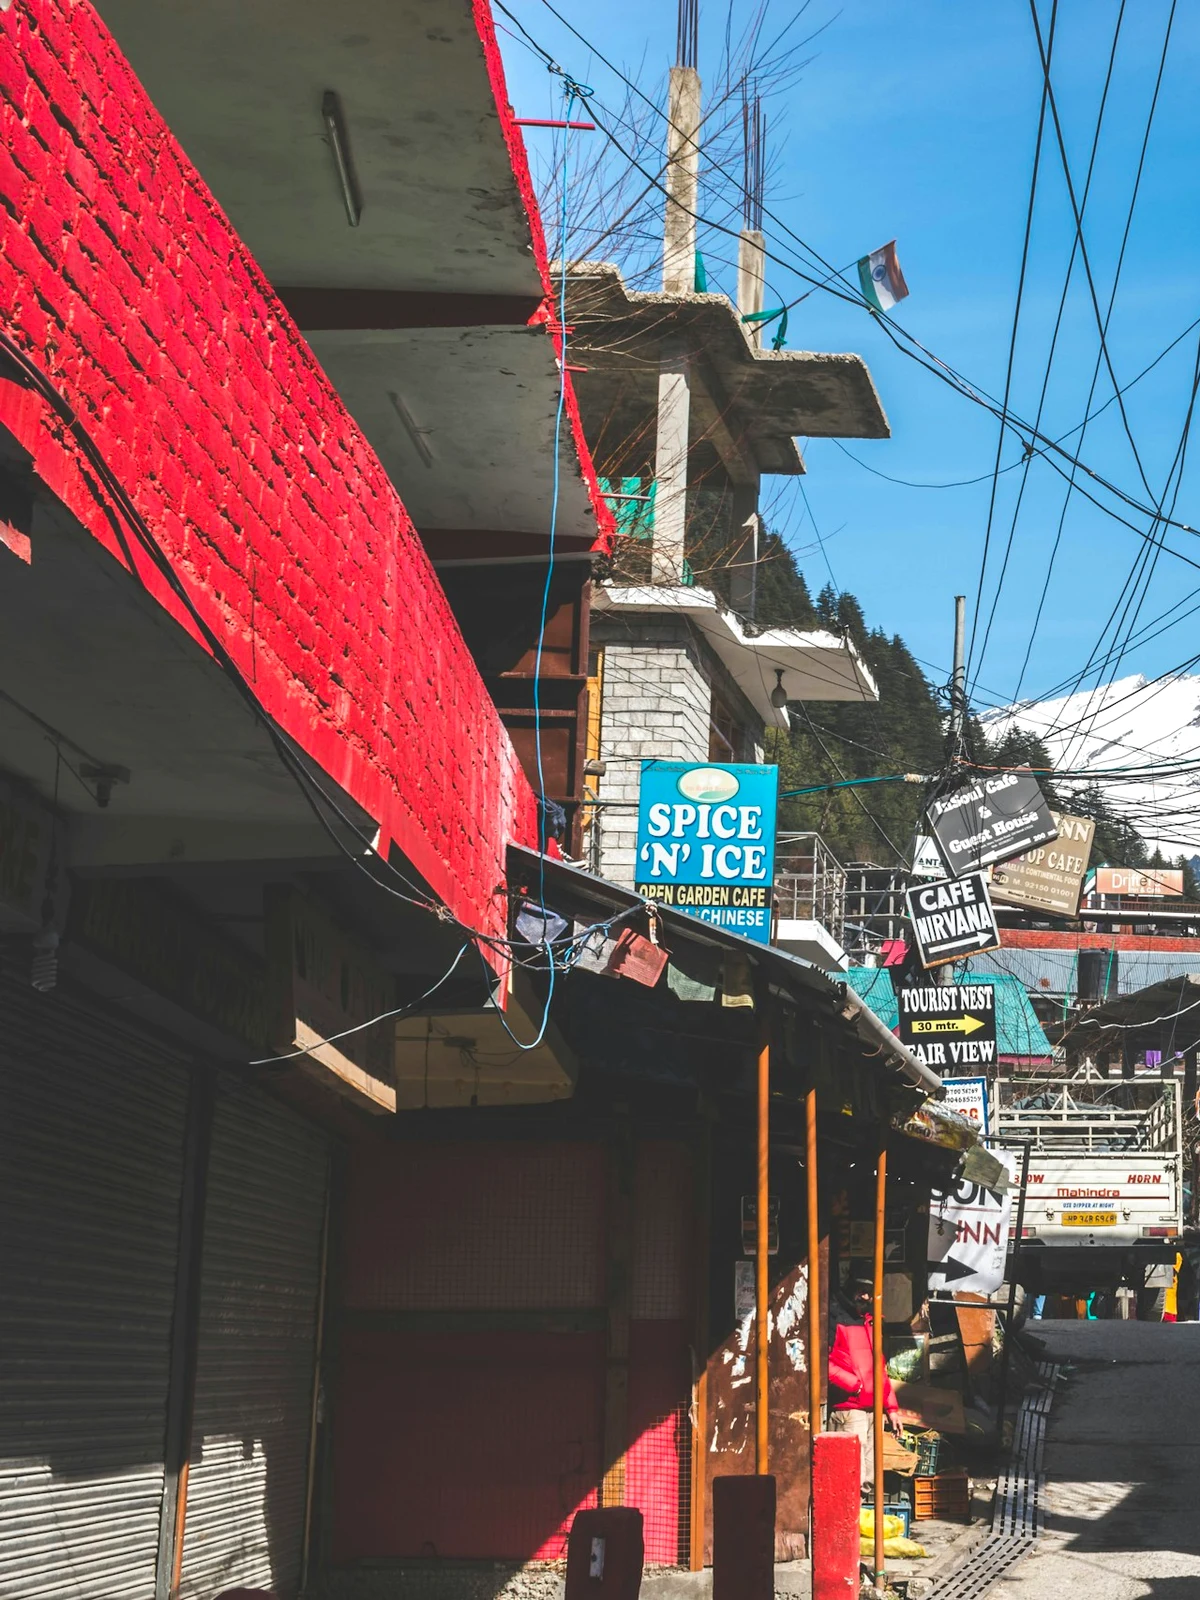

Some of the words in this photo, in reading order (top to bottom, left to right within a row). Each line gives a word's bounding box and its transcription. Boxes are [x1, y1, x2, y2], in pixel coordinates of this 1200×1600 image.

[986, 774, 1019, 795] Cafe
[647, 802, 763, 841] SPICE
[978, 806, 993, 819] &
[949, 831, 993, 854] Guest
[992, 811, 1039, 836] House
[700, 844, 767, 881] ICE
[1047, 851, 1083, 875] CAFE
[1025, 866, 1063, 883] CONTINENTAL
[1064, 875, 1080, 886] FOOD
[677, 886, 729, 906] GARDEN
[733, 888, 766, 907] CAFE
[919, 879, 976, 912] CAFE
[1024, 880, 1049, 893] 92150
[1050, 886, 1075, 899] 01001
[700, 909, 764, 926] CHINESE
[916, 902, 993, 945] NIRVANA
[902, 987, 958, 1014] TOURIST
[960, 986, 993, 1009] NEST
[917, 1021, 932, 1031] 30
[935, 1020, 959, 1030] mtr.
[949, 1040, 995, 1063] VIEW
[1014, 1174, 1045, 1184] BOW
[1127, 1174, 1161, 1184] HORN
[1057, 1187, 1120, 1197] Mahindra
[956, 1219, 1001, 1245] INN
